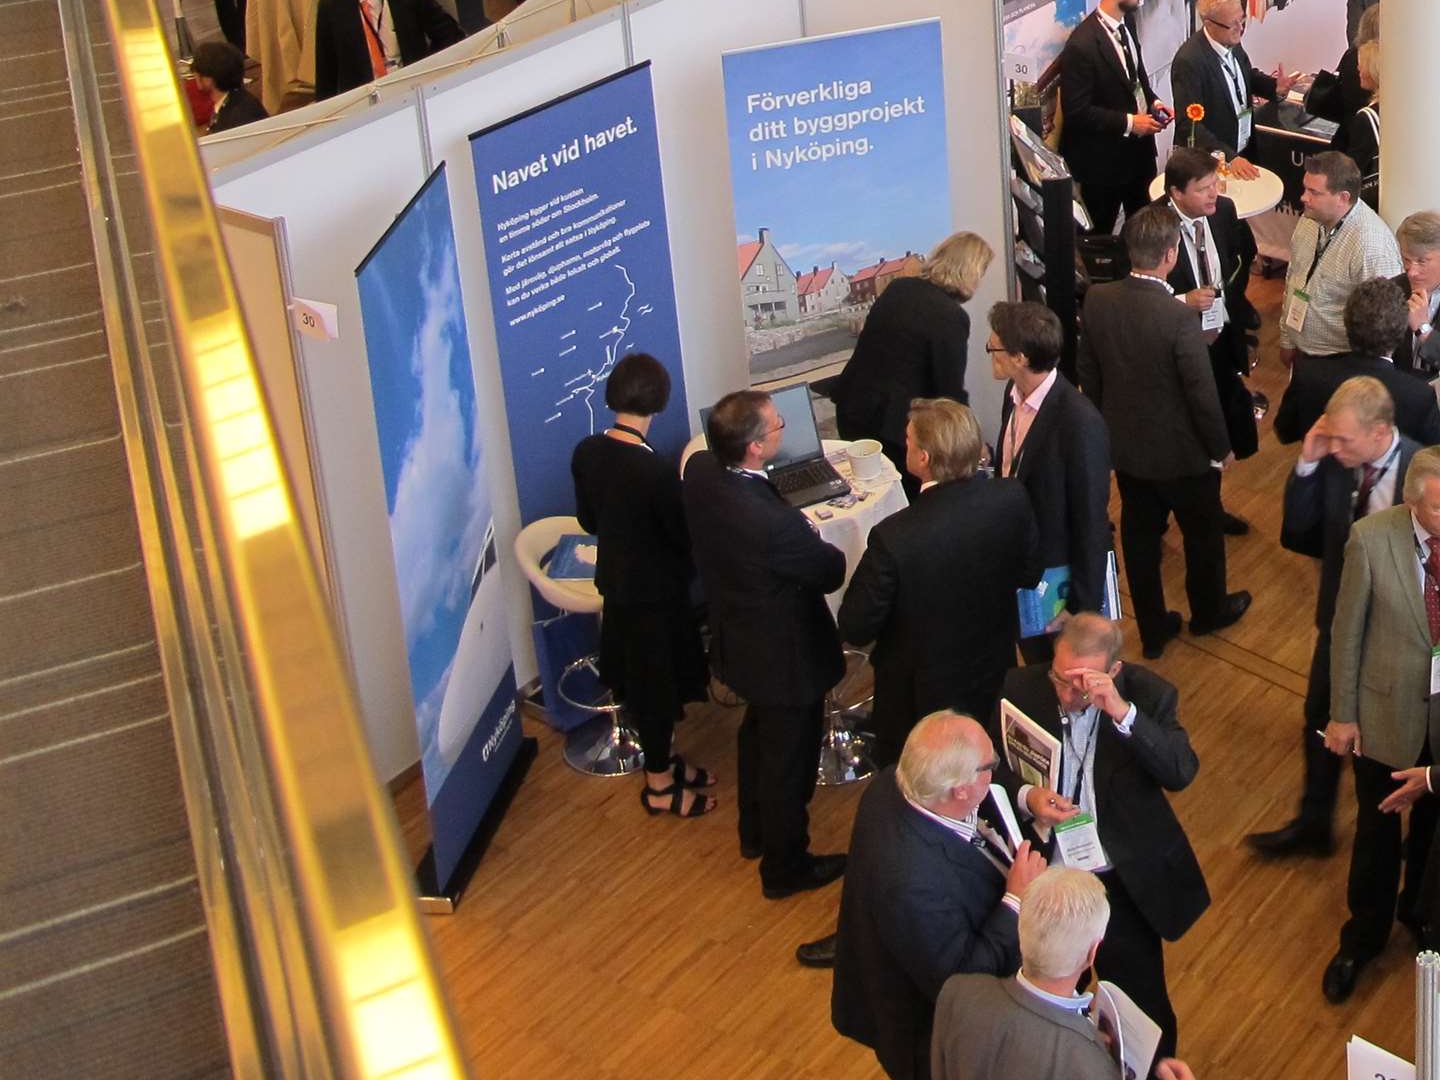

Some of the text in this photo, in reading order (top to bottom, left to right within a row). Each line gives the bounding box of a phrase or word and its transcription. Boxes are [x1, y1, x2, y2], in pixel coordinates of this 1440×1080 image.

[1015, 64, 1028, 75] 30
[746, 79, 872, 114] Förverkliga
[749, 95, 926, 142] ditt byggprojekt
[492, 116, 638, 195] Navet vid havet.
[751, 136, 874, 170] i Nyköping.
[497, 188, 584, 231] Nyköping ligger vid kusten
[501, 199, 626, 264] Korta avstånd och bra kommunikationer
[508, 224, 531, 239] timme
[531, 214, 550, 229] söder
[550, 209, 562, 219] om
[563, 193, 599, 214] Stockholm.
[505, 281, 521, 295] Med
[612, 232, 624, 243] och
[623, 219, 650, 237] flygplats
[515, 258, 528, 269] det
[528, 245, 555, 263] lönsamt
[565, 232, 583, 246] satsa
[588, 216, 616, 235] Nyköping
[506, 296, 520, 307] kan
[520, 291, 530, 301] du
[530, 281, 549, 295] verka
[587, 257, 600, 269] och
